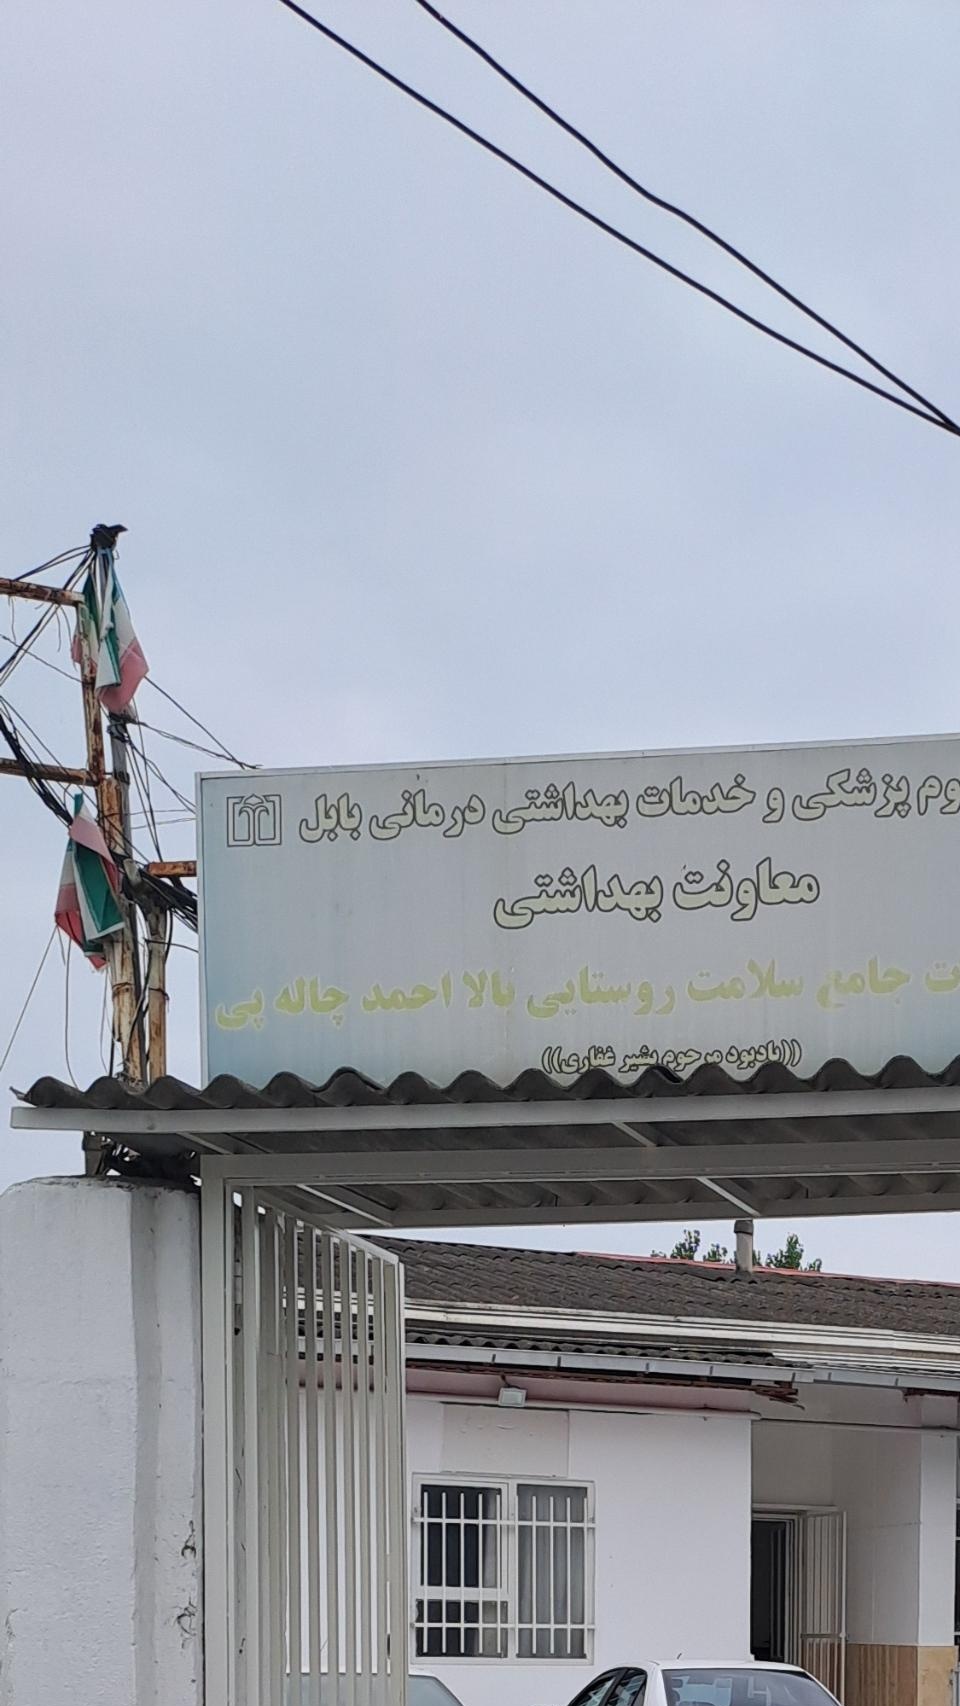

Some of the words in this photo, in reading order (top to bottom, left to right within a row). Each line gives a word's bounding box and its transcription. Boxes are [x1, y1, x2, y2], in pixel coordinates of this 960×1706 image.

[299, 793, 362, 843] بابل
[369, 788, 485, 840] درمانی
[492, 781, 630, 835] بهداشتی
[636, 773, 757, 818] خدمات
[762, 787, 785, 823] و
[791, 768, 910, 821] پزشکی
[494, 864, 663, 929] بهداشتی
[672, 857, 820, 922] معاونت
[361, 969, 453, 1013] احمد
[526, 964, 678, 1020] روستایی
[686, 957, 805, 1003] سلامت
[815, 955, 912, 1012] جامع
